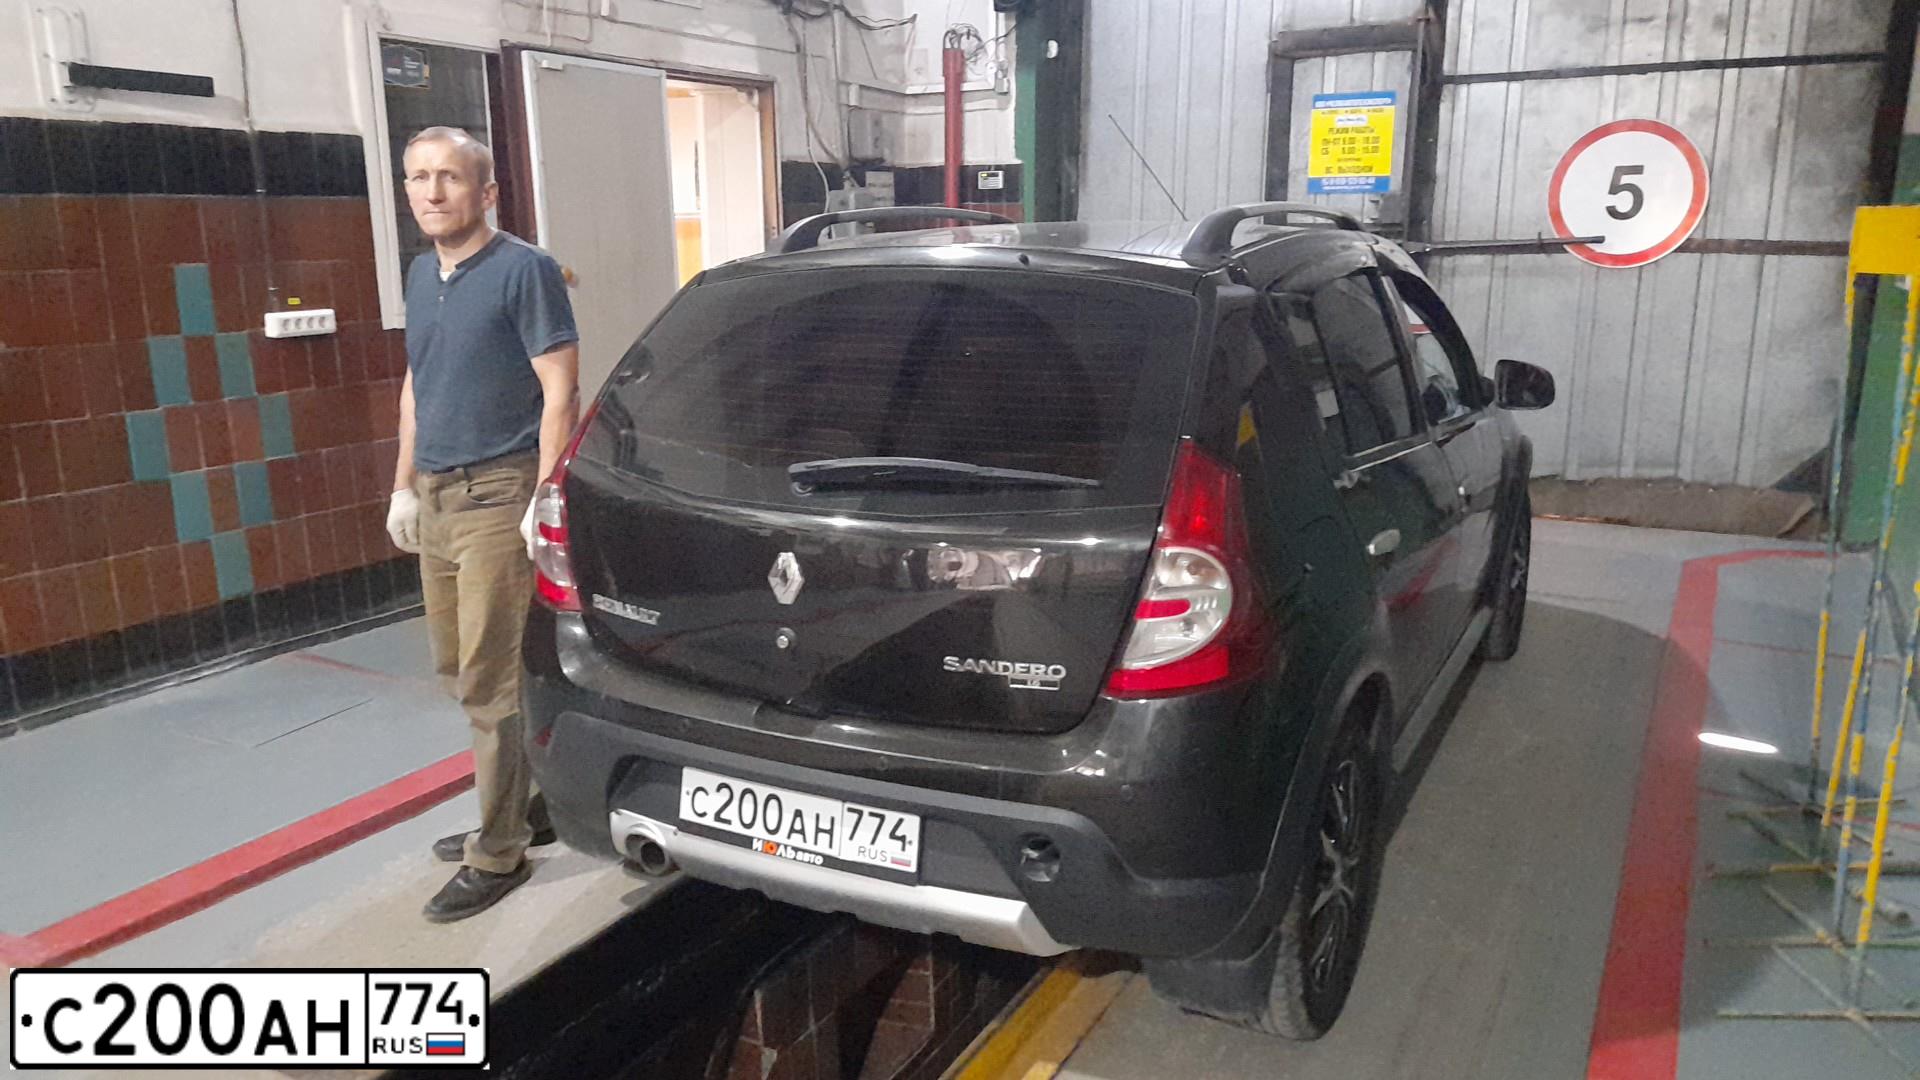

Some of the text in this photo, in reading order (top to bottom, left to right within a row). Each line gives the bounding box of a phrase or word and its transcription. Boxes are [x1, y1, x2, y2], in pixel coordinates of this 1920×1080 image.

[1605, 164, 1645, 221] 5
[943, 656, 1066, 679] SANDERO
[847, 807, 908, 851] 774
[857, 846, 888, 863] RUS
